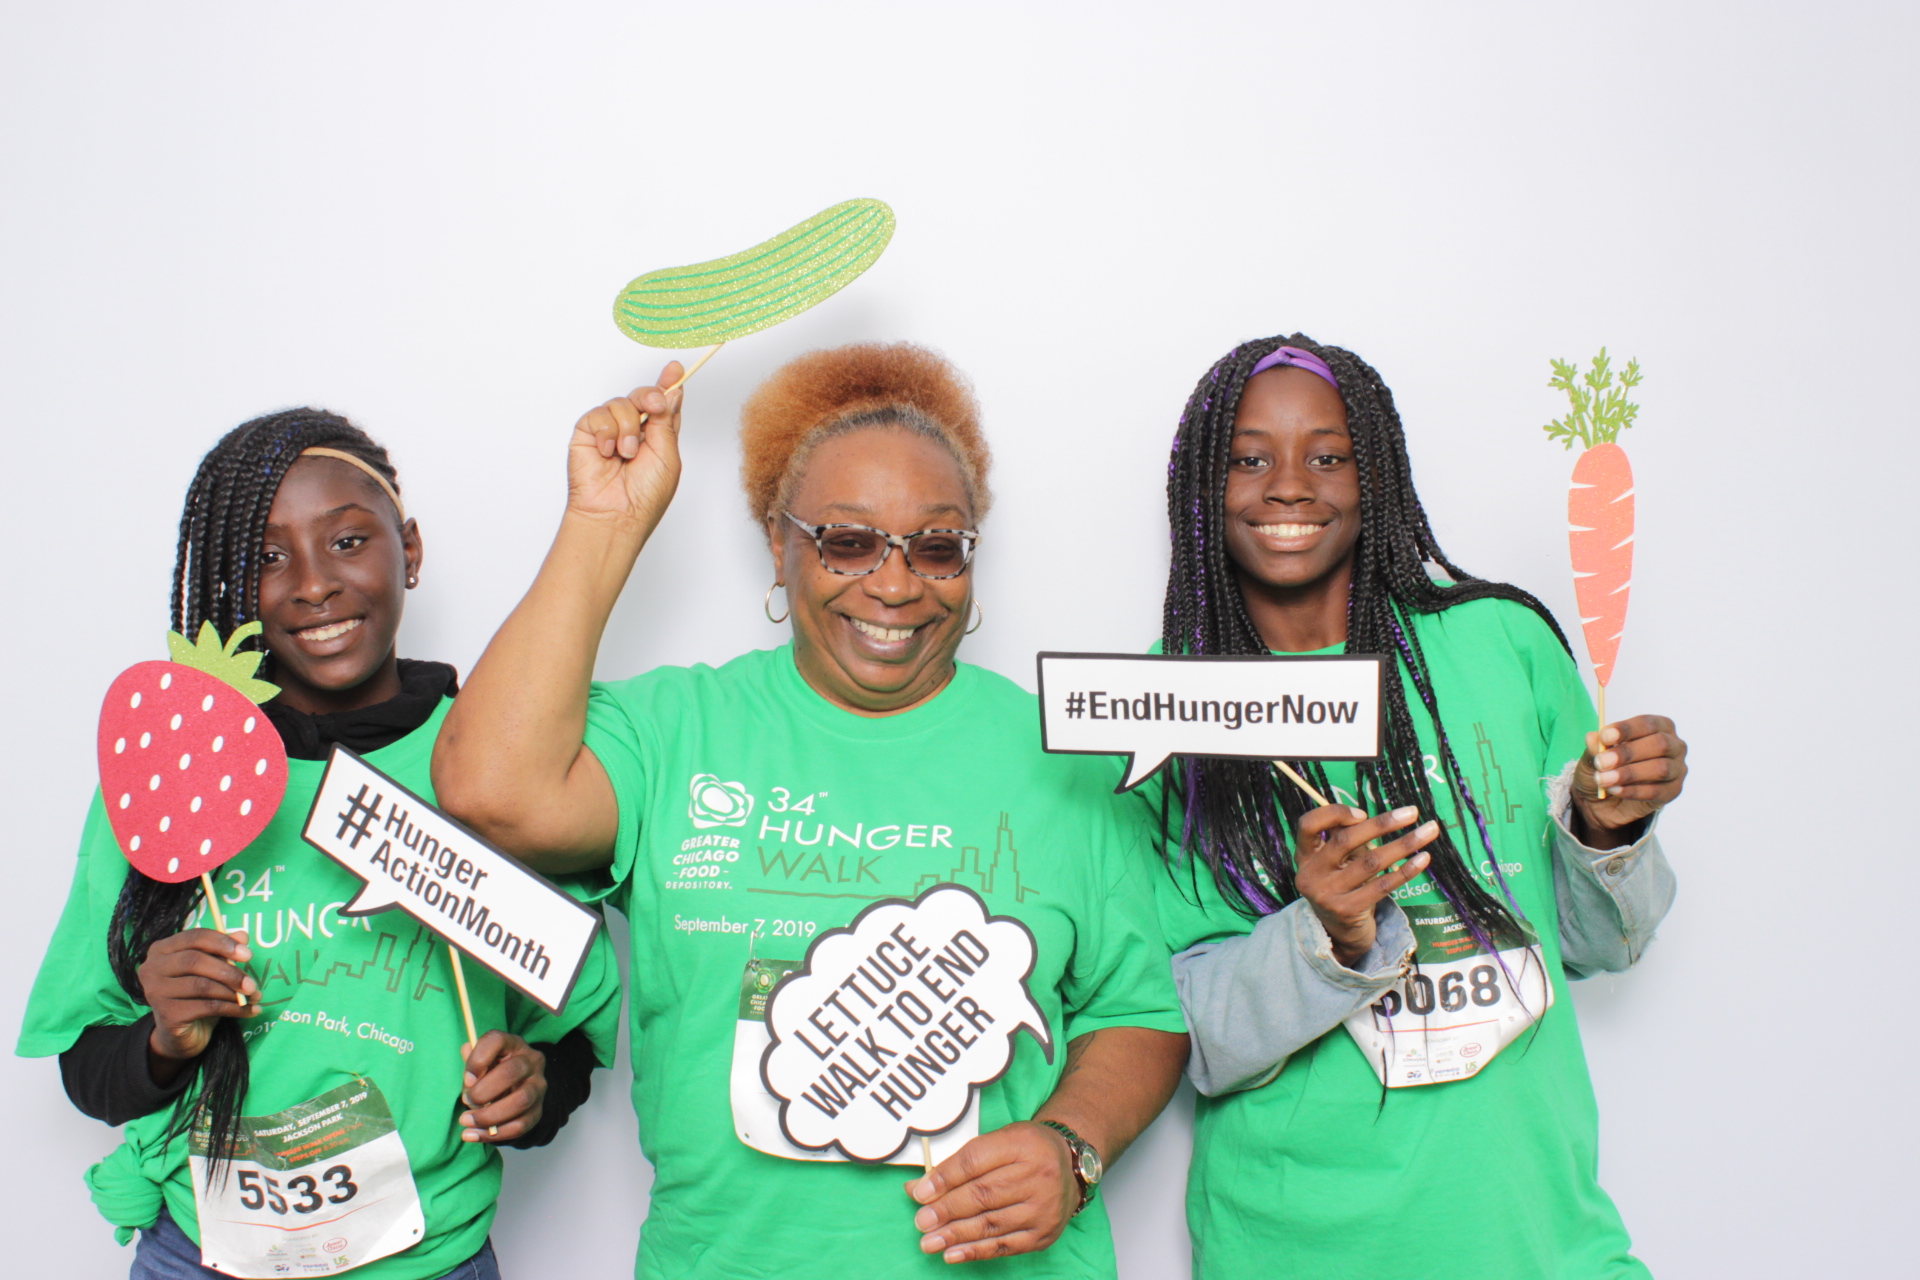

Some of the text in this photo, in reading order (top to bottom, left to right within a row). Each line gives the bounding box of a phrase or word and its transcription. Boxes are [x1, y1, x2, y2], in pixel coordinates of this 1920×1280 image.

[1065, 691, 1359, 730] #EndHungerNow
[681, 834, 741, 851] GREATER
[758, 814, 954, 850] HUNGER
[672, 849, 740, 866] CHICAGO
[757, 845, 884, 885] WALK
[369, 839, 551, 981] ActionMonth
[1392, 880, 1441, 901] ackson
[674, 914, 749, 936] September
[772, 919, 817, 938] 2019
[1415, 915, 1454, 926] SATURDAY,
[793, 922, 931, 1062] LETTUCE
[315, 1011, 351, 1037] Park,
[357, 1022, 415, 1054] Chicago
[800, 929, 990, 1120] WALK TO END
[869, 995, 996, 1122] HUNGER
[254, 1092, 368, 1138] SATURDAY, SEPTEMBER 7, 2019
[283, 1114, 344, 1144] JACKSON PARK
[237, 1164, 359, 1216] 5533
